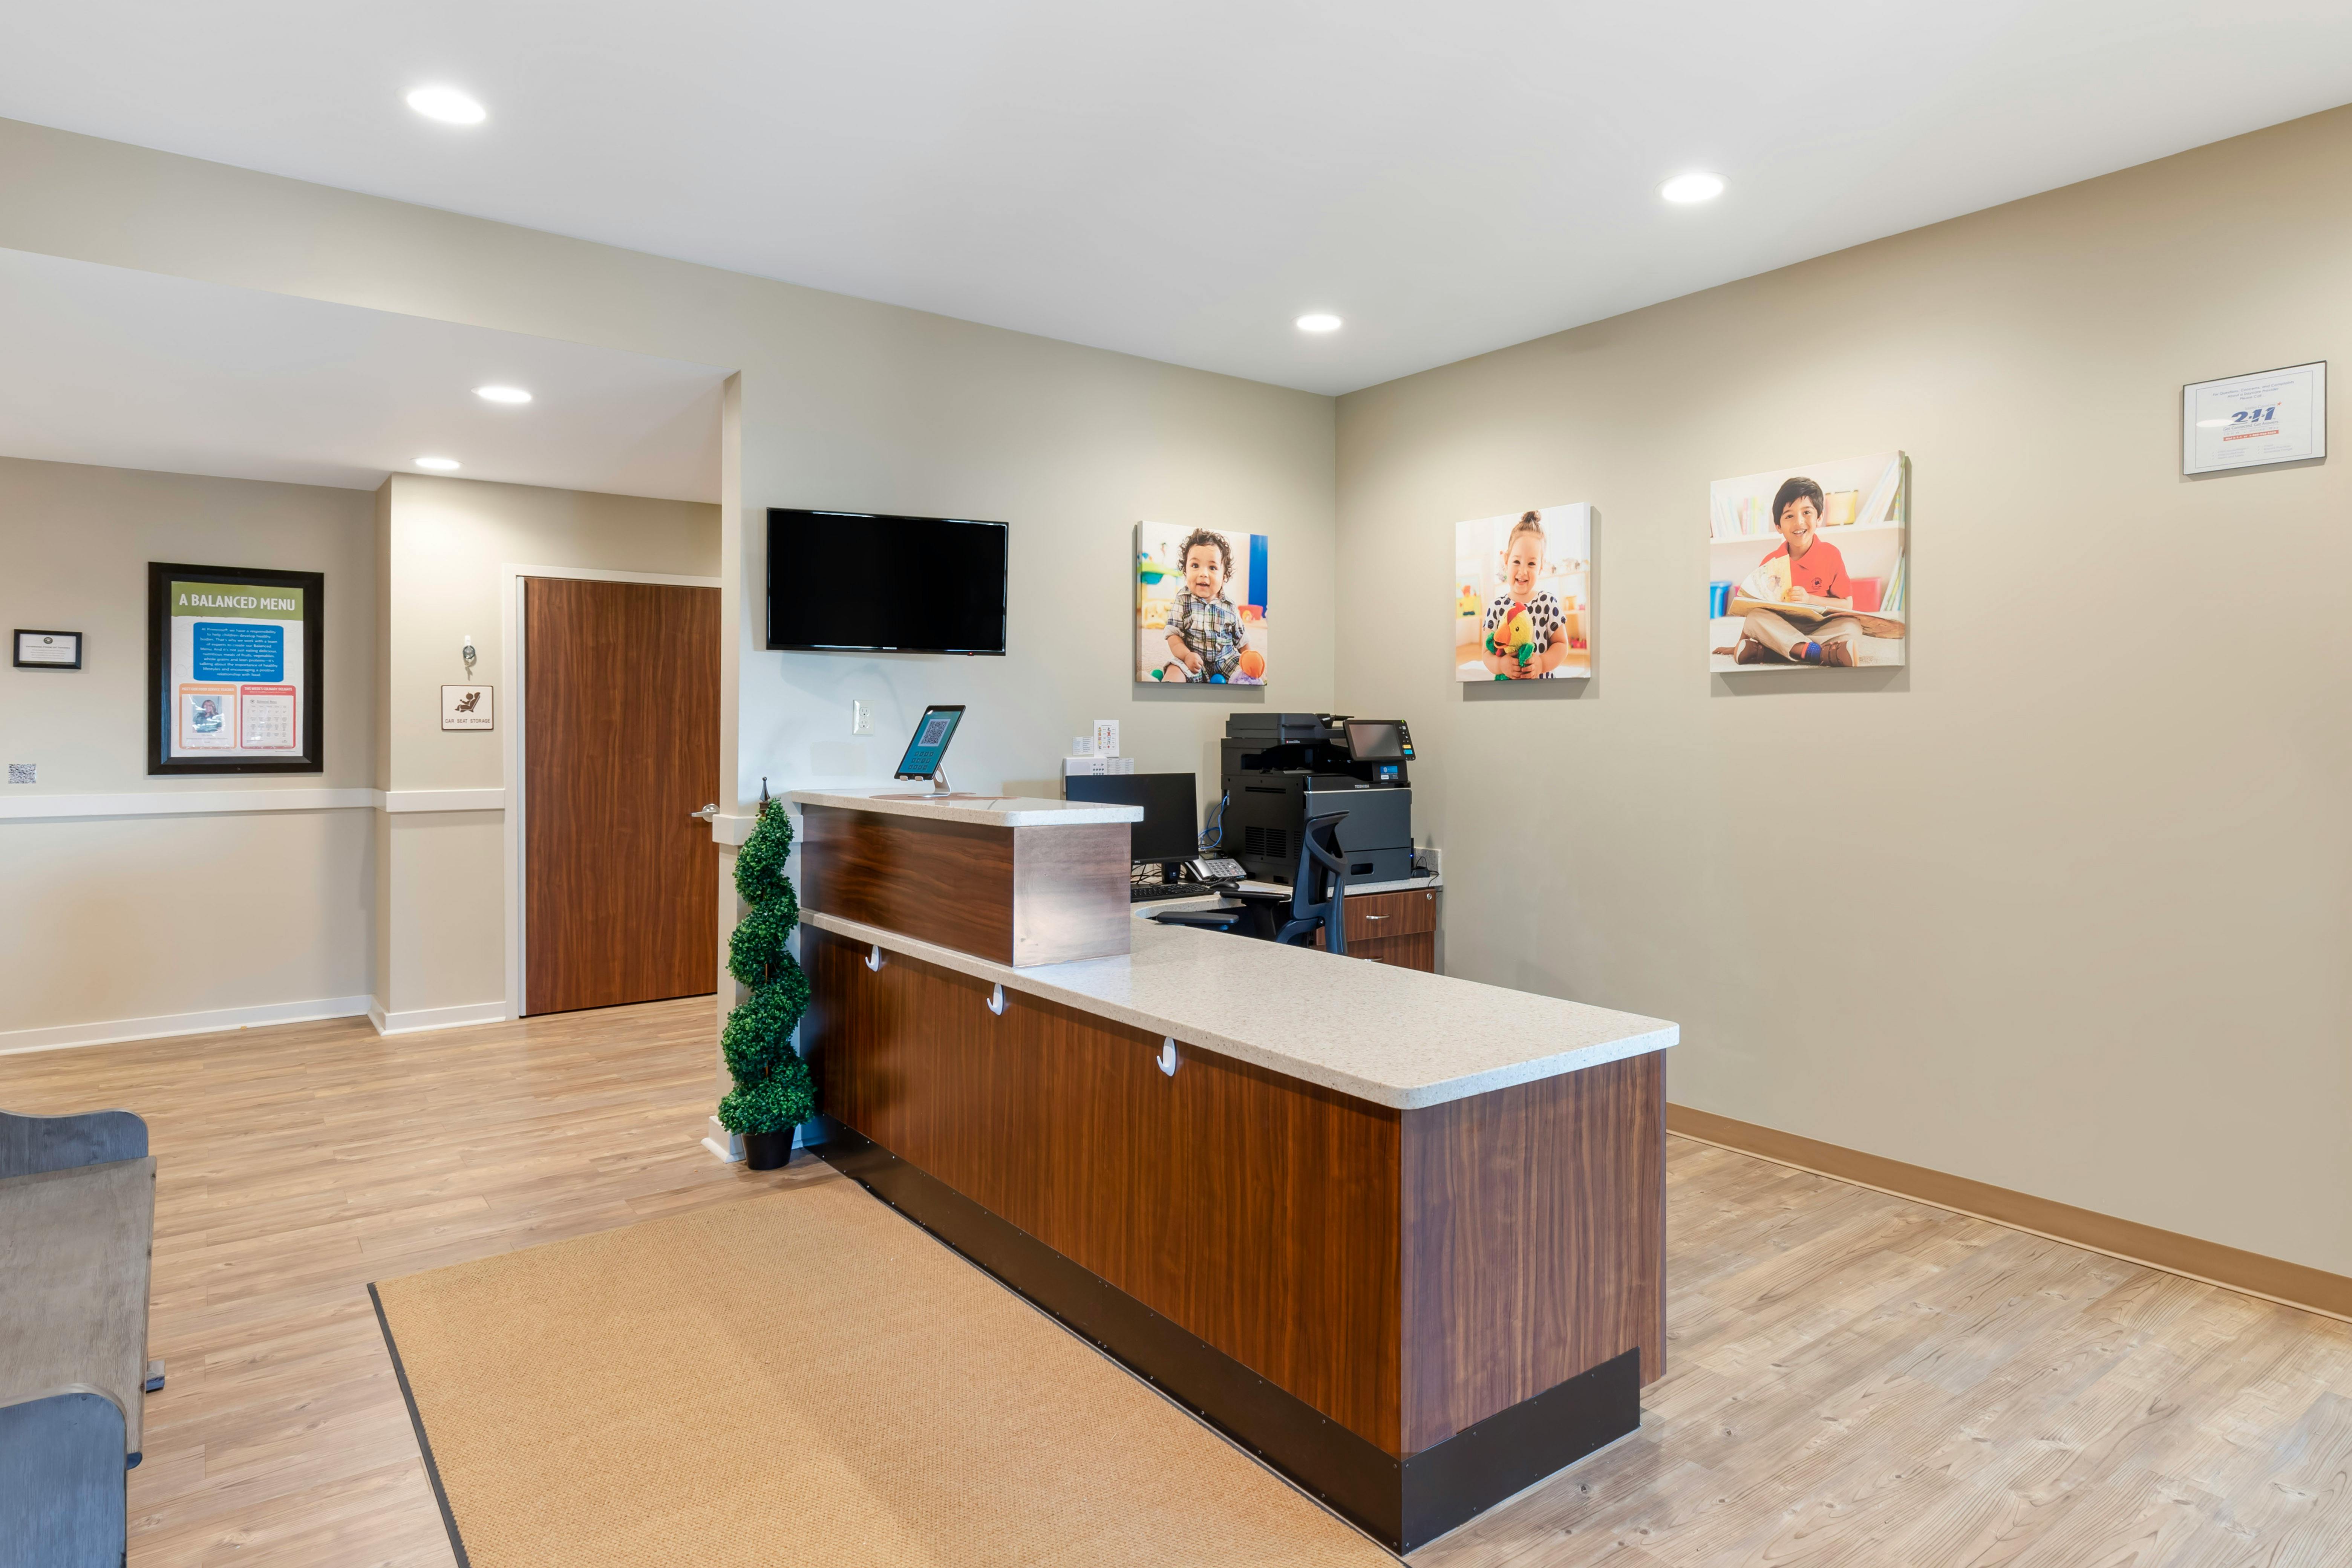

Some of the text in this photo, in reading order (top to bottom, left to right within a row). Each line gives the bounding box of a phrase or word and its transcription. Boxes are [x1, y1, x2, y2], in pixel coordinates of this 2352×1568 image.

[179, 594, 295, 611] A BALANCED MENU
